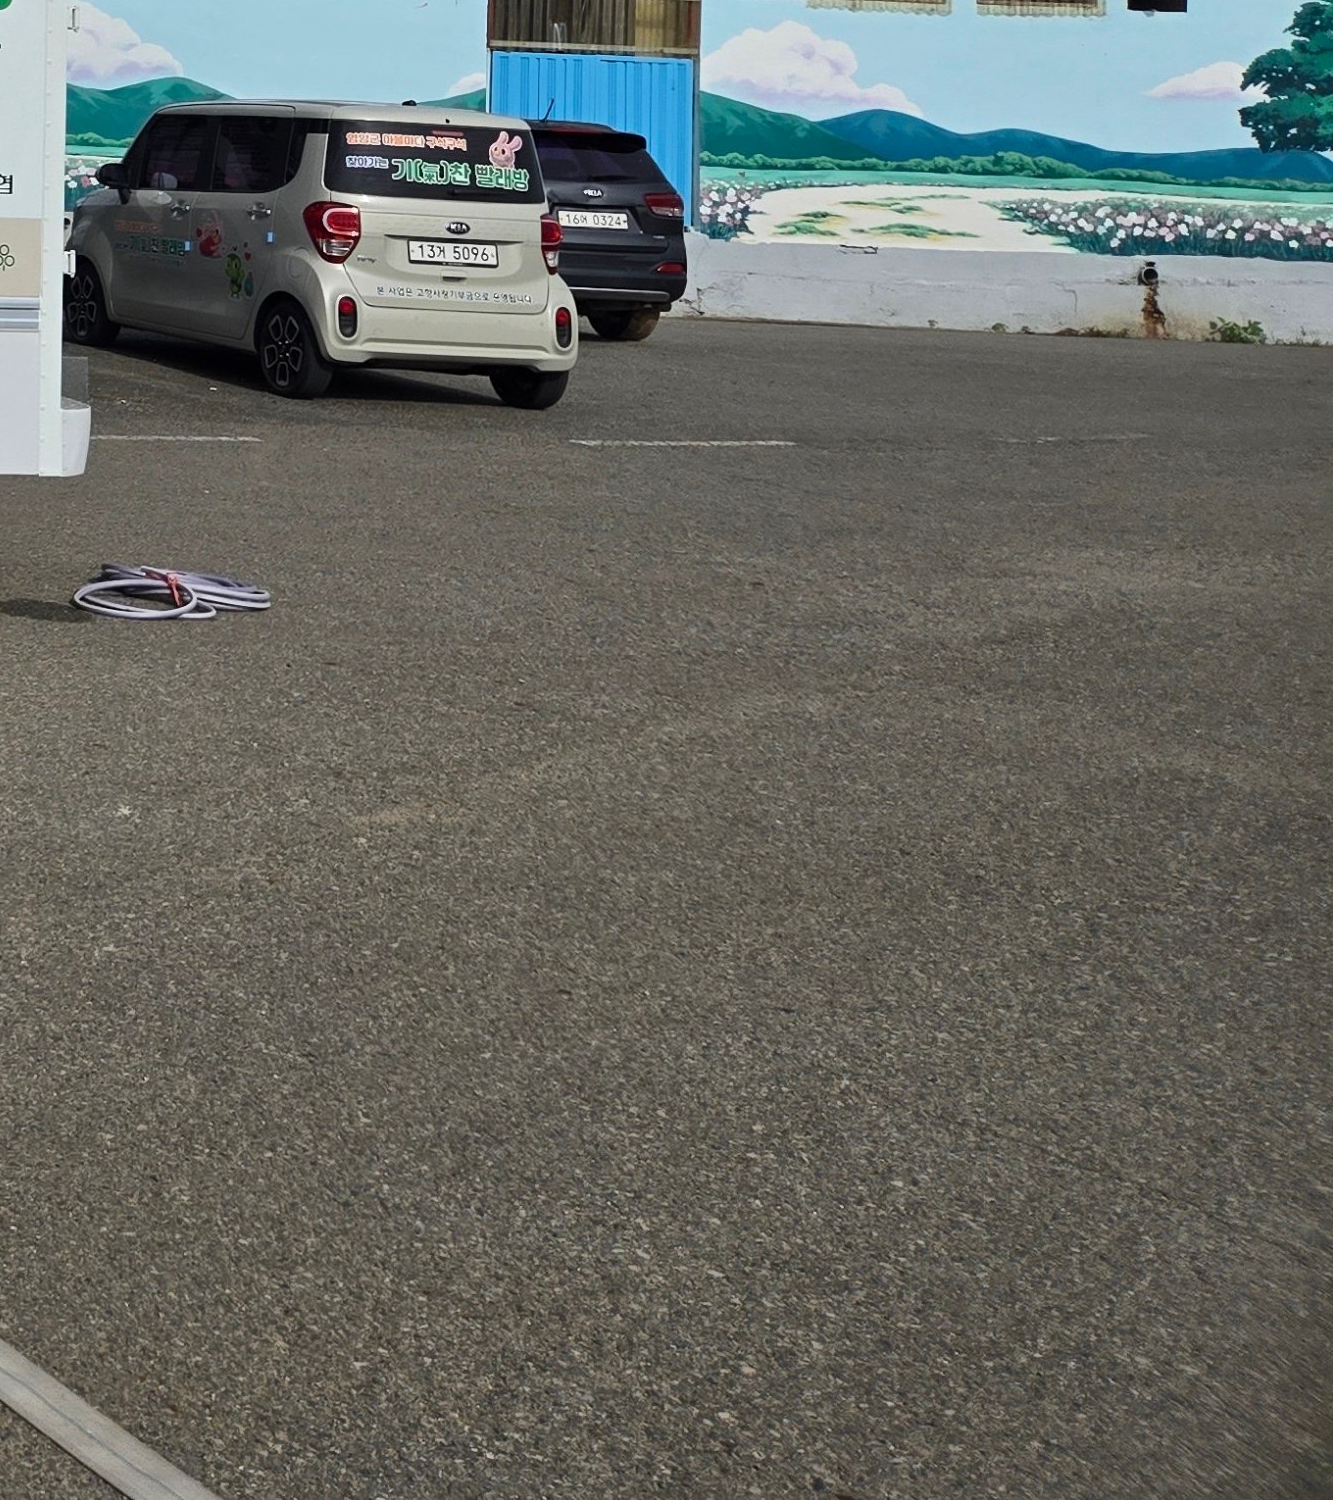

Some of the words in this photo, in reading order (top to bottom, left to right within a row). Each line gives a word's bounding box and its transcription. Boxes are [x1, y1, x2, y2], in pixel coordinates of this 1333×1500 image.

[475, 164, 529, 192] 빨래방
[592, 214, 622, 226] 0324
[453, 246, 489, 262] 5096
